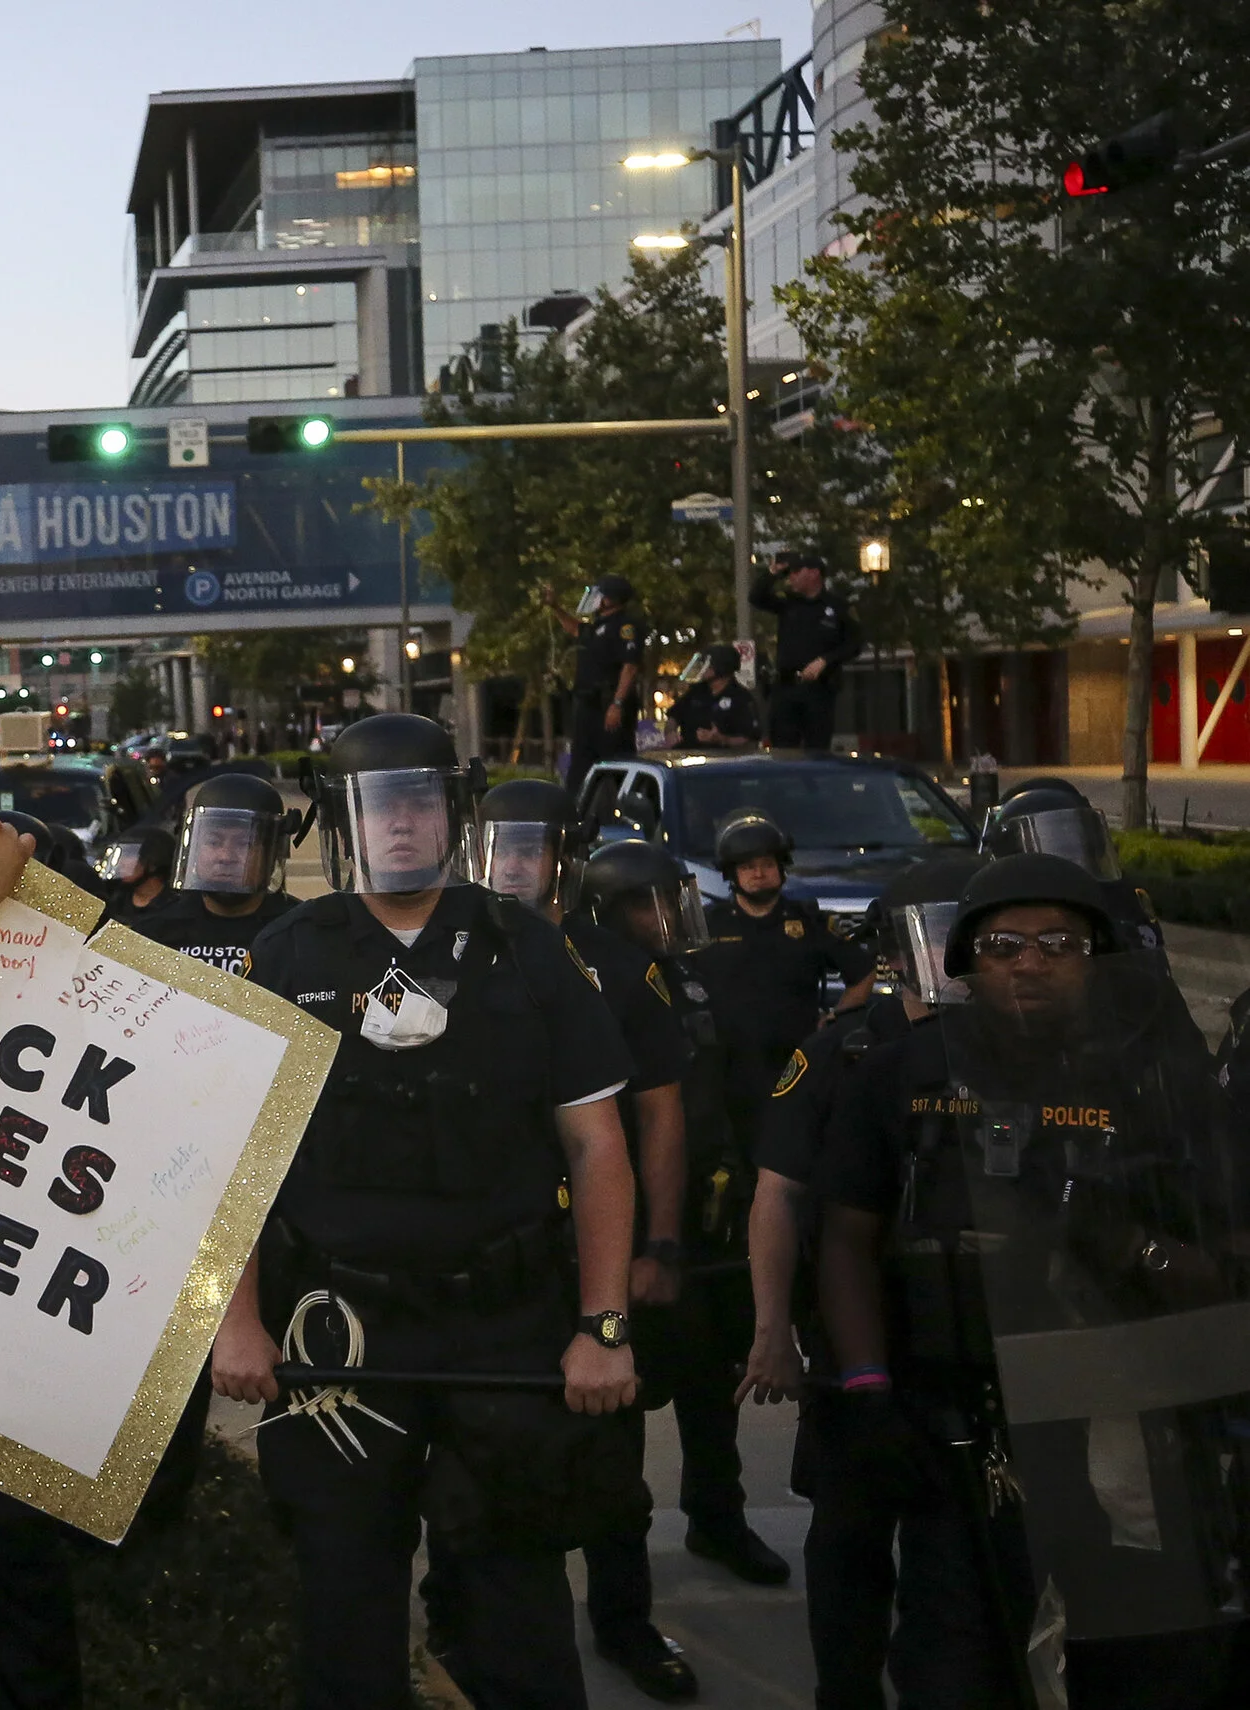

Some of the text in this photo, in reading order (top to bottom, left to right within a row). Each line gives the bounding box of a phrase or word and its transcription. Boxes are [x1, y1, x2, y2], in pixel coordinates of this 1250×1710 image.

[37, 492, 231, 550] HOUSTON
[40, 574, 57, 592] OF
[59, 569, 158, 590] ENTERTAINMENT
[224, 571, 292, 586] AVENIDA
[224, 583, 341, 601] NORTH GARAGE
[180, 945, 247, 958] HOUSTO
[297, 990, 336, 1005] STEPHENS
[949, 1100, 979, 1114] DAVIS
[1042, 1105, 1110, 1129] POLICE
